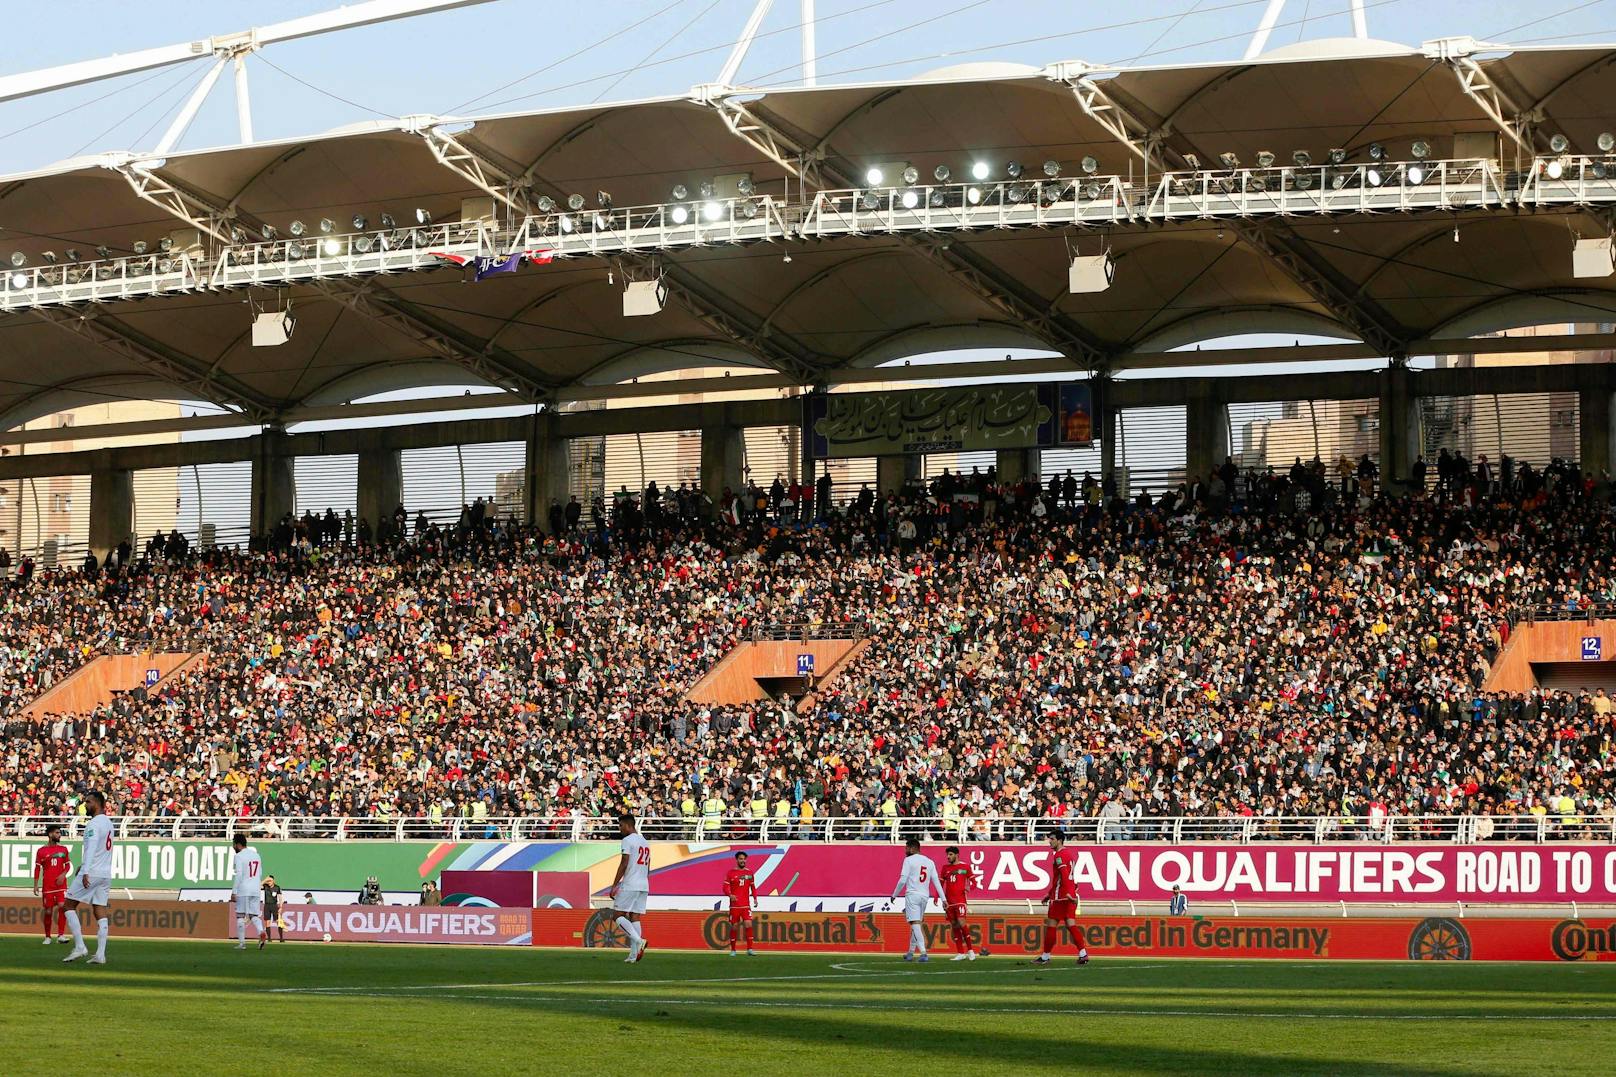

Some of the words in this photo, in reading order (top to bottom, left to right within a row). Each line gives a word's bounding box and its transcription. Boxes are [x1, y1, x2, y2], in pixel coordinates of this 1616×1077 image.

[105, 830, 112, 851] 6
[51, 857, 58, 867] 10
[148, 845, 176, 880] TO
[248, 860, 259, 878] 17
[919, 865, 928, 883] 5
[970, 850, 985, 890] AFC
[988, 850, 1141, 891] ASAN
[1151, 850, 1446, 893] QUALIFIERS
[1456, 850, 1541, 893] ROAD
[1553, 851, 1592, 894] TO
[107, 902, 200, 935] ermany
[346, 911, 497, 936] QUALIFIERS
[1159, 918, 1185, 947] in
[1193, 920, 1328, 955] Germany
